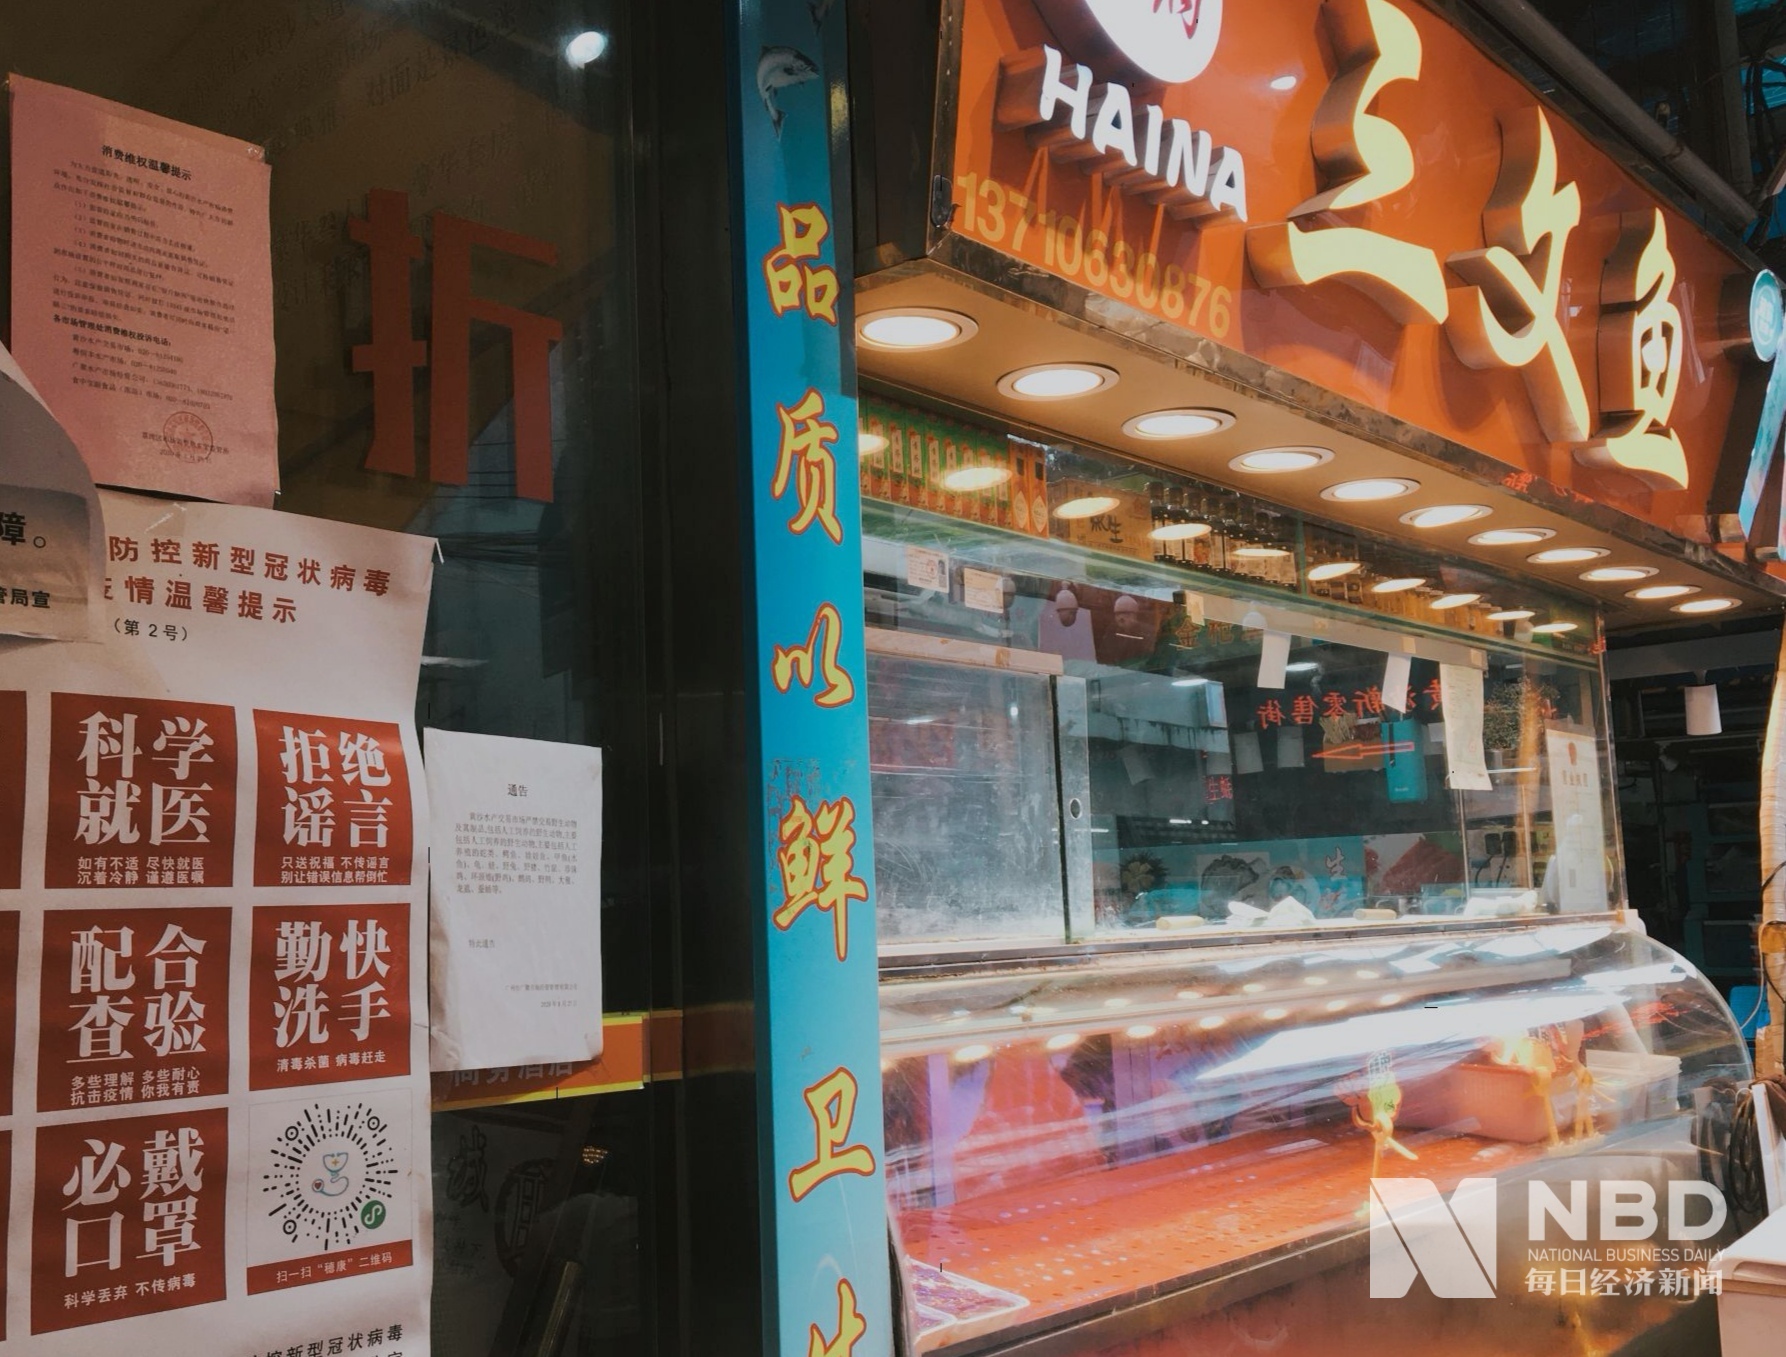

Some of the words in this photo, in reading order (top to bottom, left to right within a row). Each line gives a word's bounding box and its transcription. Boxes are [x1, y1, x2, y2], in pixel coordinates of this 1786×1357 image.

[102, 145, 191, 181] 消费维权温馨提示
[1039, 44, 1248, 222] HAINA
[957, 171, 1233, 340] 13710630876
[1287, 0, 1688, 489] 三文鱼
[348, 188, 563, 503] 折
[109, 535, 391, 597] 防控新型冠状病毒
[78, 711, 215, 782] 科学
[281, 725, 392, 788] 拒绝
[74, 778, 211, 847] 就医
[281, 785, 390, 848] 谣言
[507, 784, 528, 798] 通告
[78, 856, 139, 871] 如有不适
[146, 856, 205, 871] 尽快就医
[78, 869, 139, 885] 沉着冷静
[146, 869, 205, 885] 谨遵医嘱
[281, 856, 334, 870] 只送祝福
[341, 856, 389, 870] 不传谣言
[281, 869, 389, 885] 别让错误信息帮倒忙
[71, 924, 208, 994] 配合
[276, 918, 391, 984] 勤快
[66, 992, 207, 1064] 查验
[273, 983, 391, 1048] 洗手
[71, 1072, 135, 1090] 多些理解
[142, 1067, 201, 1084] 多些耐心
[335, 1050, 386, 1067] 病毒赶走
[70, 1087, 133, 1106] 抗击疫情
[142, 1081, 200, 1099] 你我有责
[62, 1126, 205, 1210] 必戴
[65, 1196, 202, 1278] 口罩
[276, 1264, 313, 1284] 扫一扫
[359, 1251, 393, 1270] 二维码
[64, 1283, 128, 1310] 科学丢弃
[135, 1273, 197, 1296] 不传病毒
